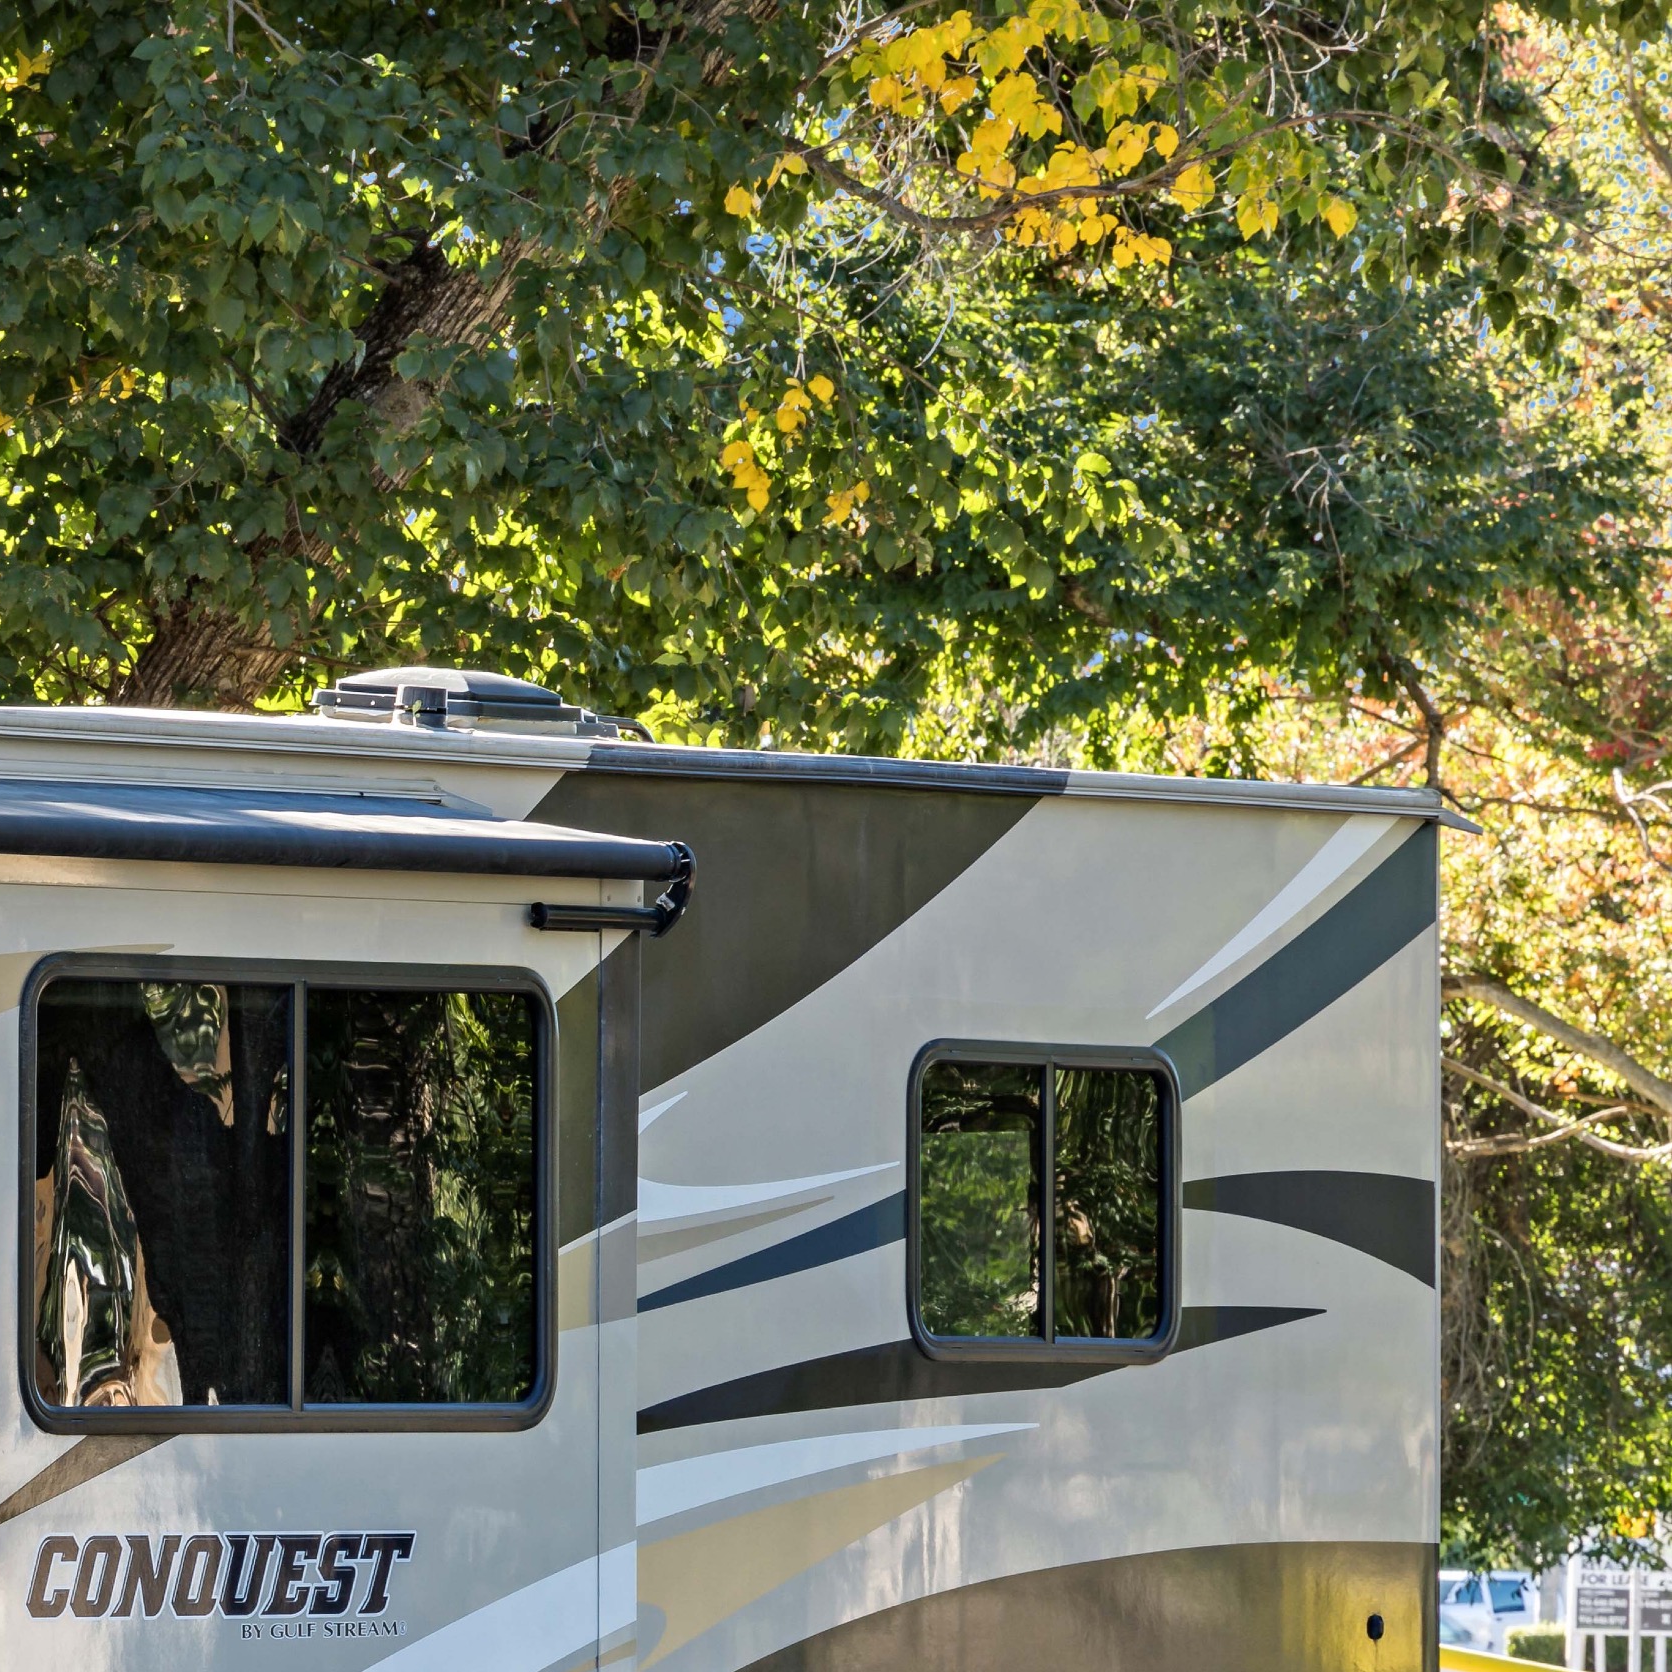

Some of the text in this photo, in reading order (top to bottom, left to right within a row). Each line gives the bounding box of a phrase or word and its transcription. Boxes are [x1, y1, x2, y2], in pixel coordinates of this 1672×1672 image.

[27, 1532, 416, 1619] CONQUEST
[241, 1623, 264, 1639] BY
[270, 1622, 316, 1639] GULF
